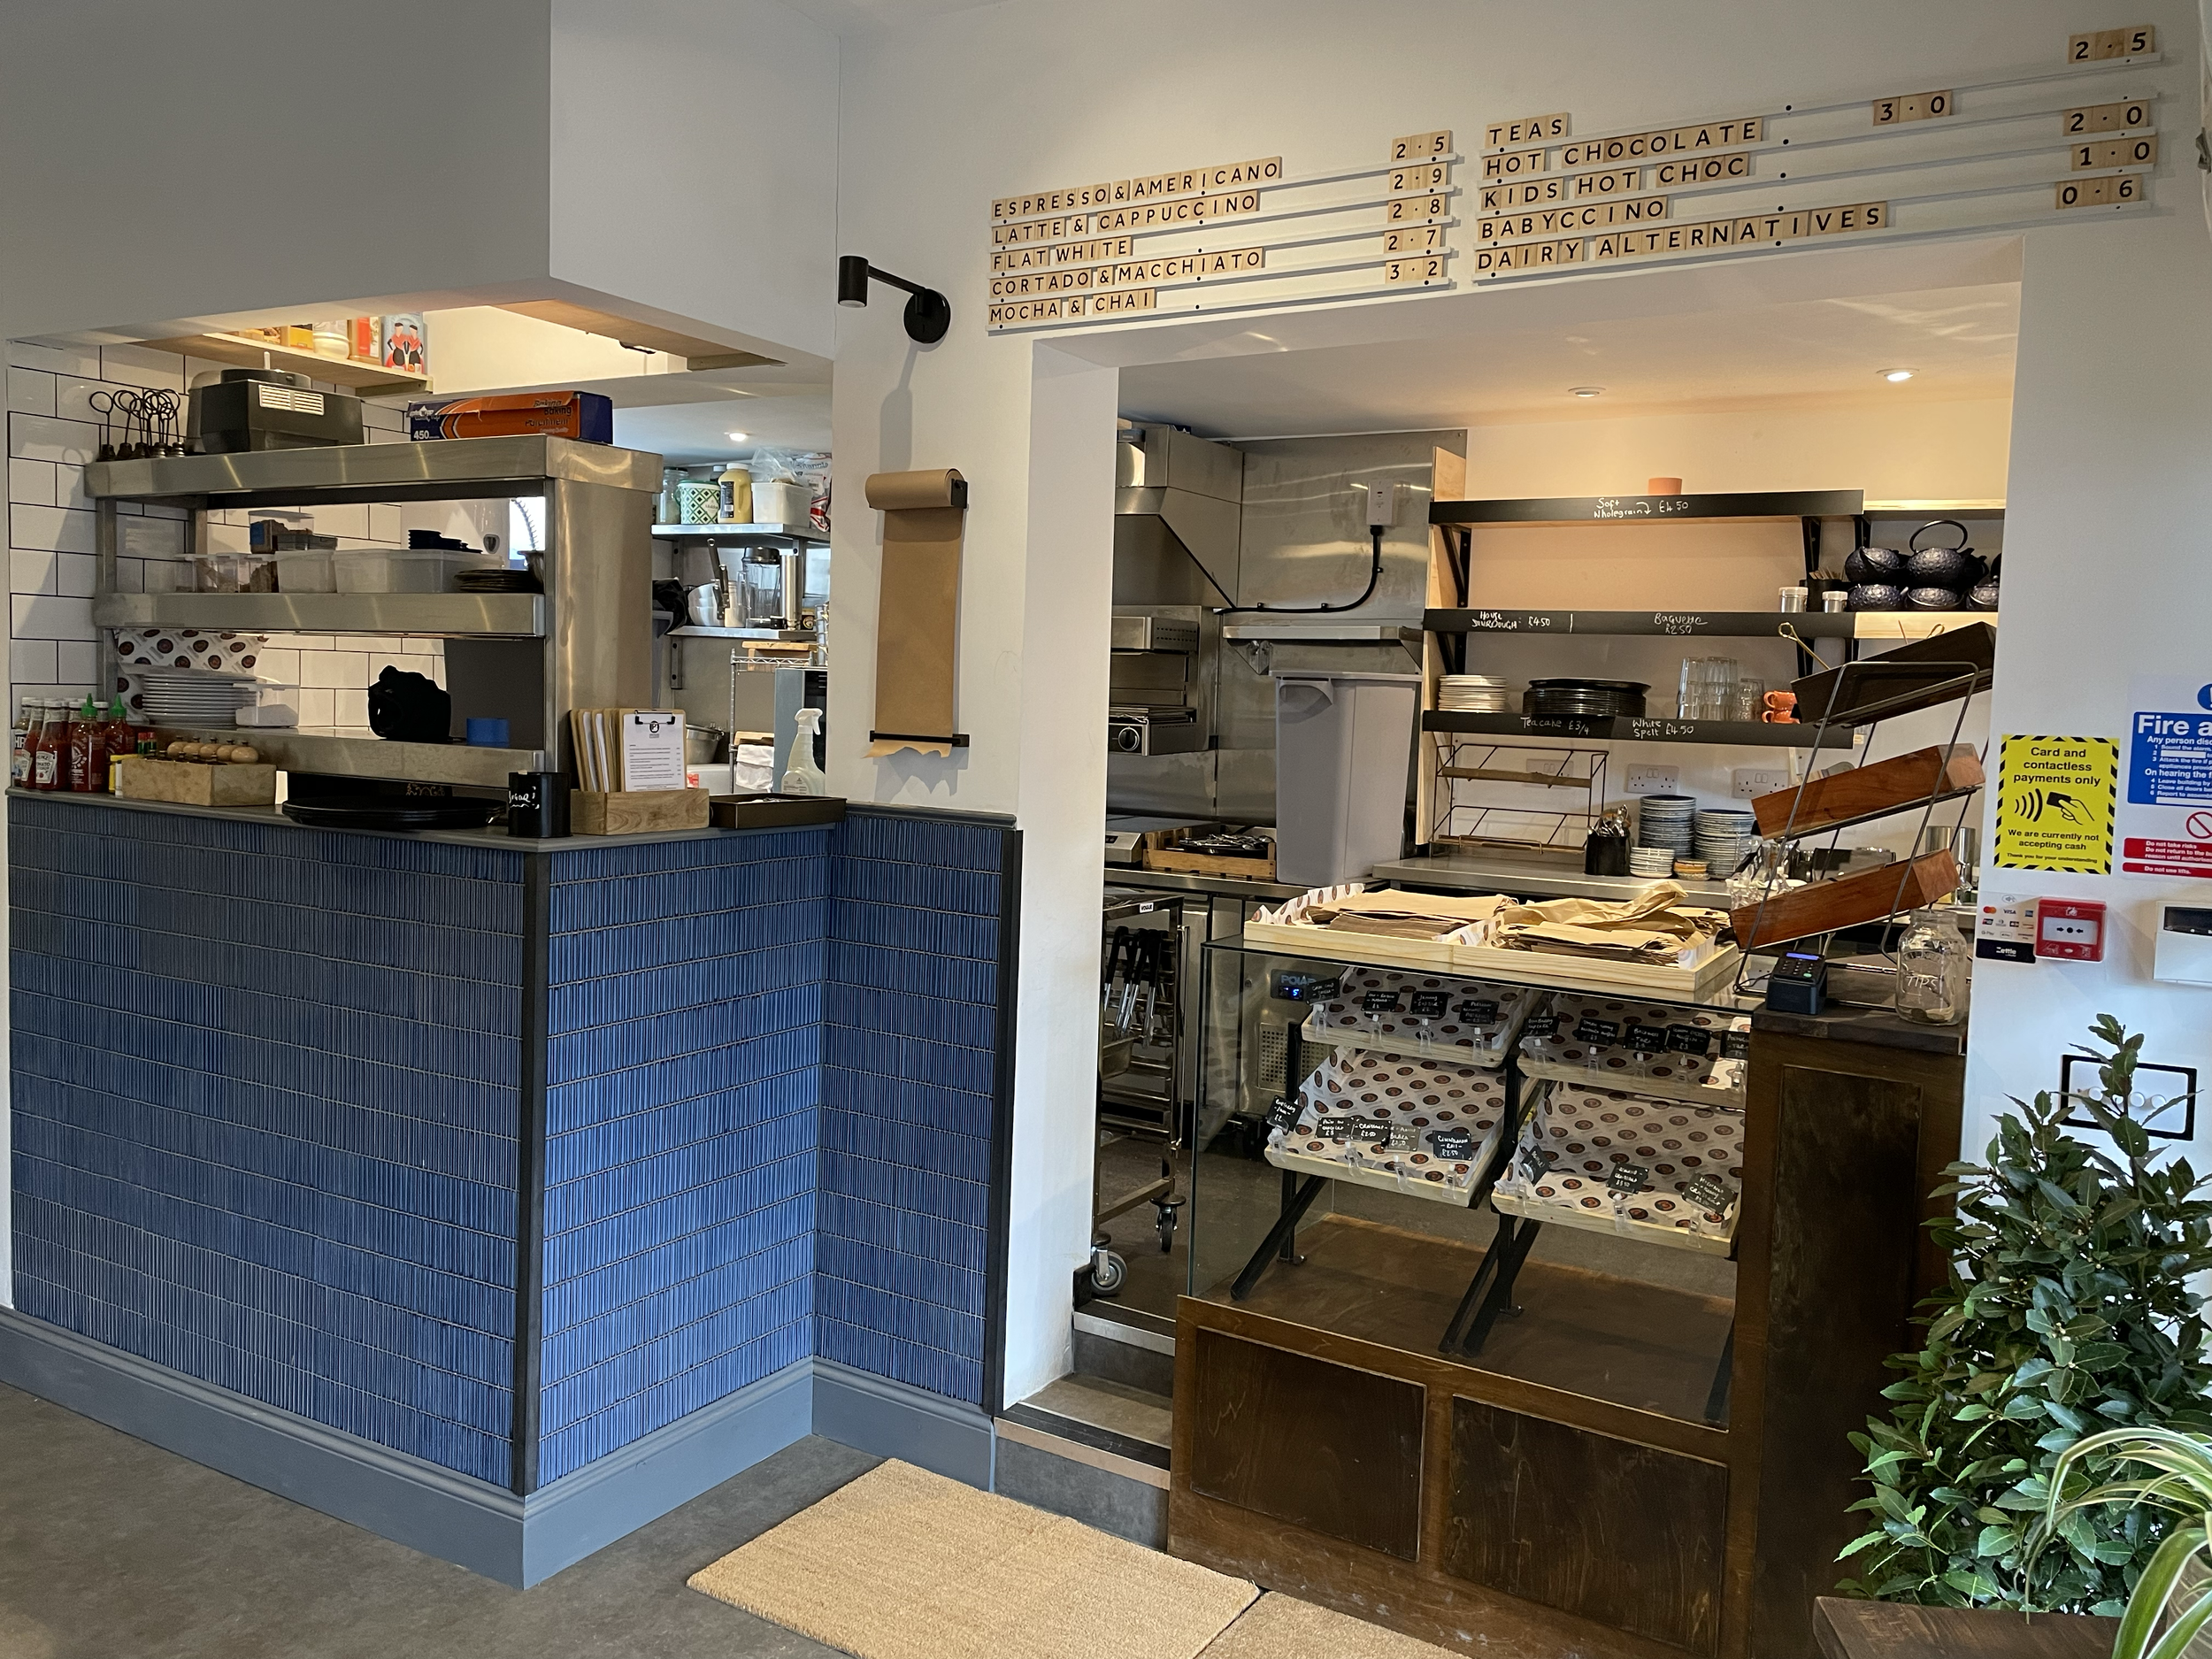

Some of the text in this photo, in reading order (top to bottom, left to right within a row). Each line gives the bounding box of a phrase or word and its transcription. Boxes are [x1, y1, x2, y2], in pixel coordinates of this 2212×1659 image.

[1489, 119, 1563, 144] TEAS
[1486, 153, 1541, 176] HOT
[1564, 122, 1756, 165] CHOCOLATE
[995, 189, 1106, 217] ESPRESSO
[1115, 186, 1124, 199] &
[1135, 163, 1277, 196] AMERICANO
[1485, 182, 1558, 207] KIDS
[1578, 173, 1636, 194] HOT
[1660, 157, 1744, 183] CHOC
[995, 222, 1061, 243] LATTE
[1074, 219, 1083, 232] &
[1100, 196, 1254, 229] CAPPUCCINO
[1481, 201, 1663, 239] BABYCCINO
[1478, 242, 1578, 269] DAIRY
[1599, 208, 1879, 257] ALTERNATIVES
[995, 250, 1046, 269] FLAT
[1056, 241, 1126, 262] WHITE
[993, 273, 1088, 295] CORTADO
[1100, 270, 1109, 283] &
[1119, 252, 1259, 280] MACCHIATO
[991, 303, 1057, 321] MOCHA
[1071, 301, 1080, 313] &
[1095, 293, 1147, 311] CHAI
[414, 430, 429, 440] 450
[1632, 718, 1661, 727] White
[1633, 728, 1659, 739] Spelt
[2138, 715, 2190, 735] Fire
[2031, 747, 2060, 757] Card
[2024, 761, 2092, 772] contactless
[2159, 769, 2191, 779] hearing
[2013, 774, 2101, 787] payments only
[2018, 840, 2062, 849] accepting
